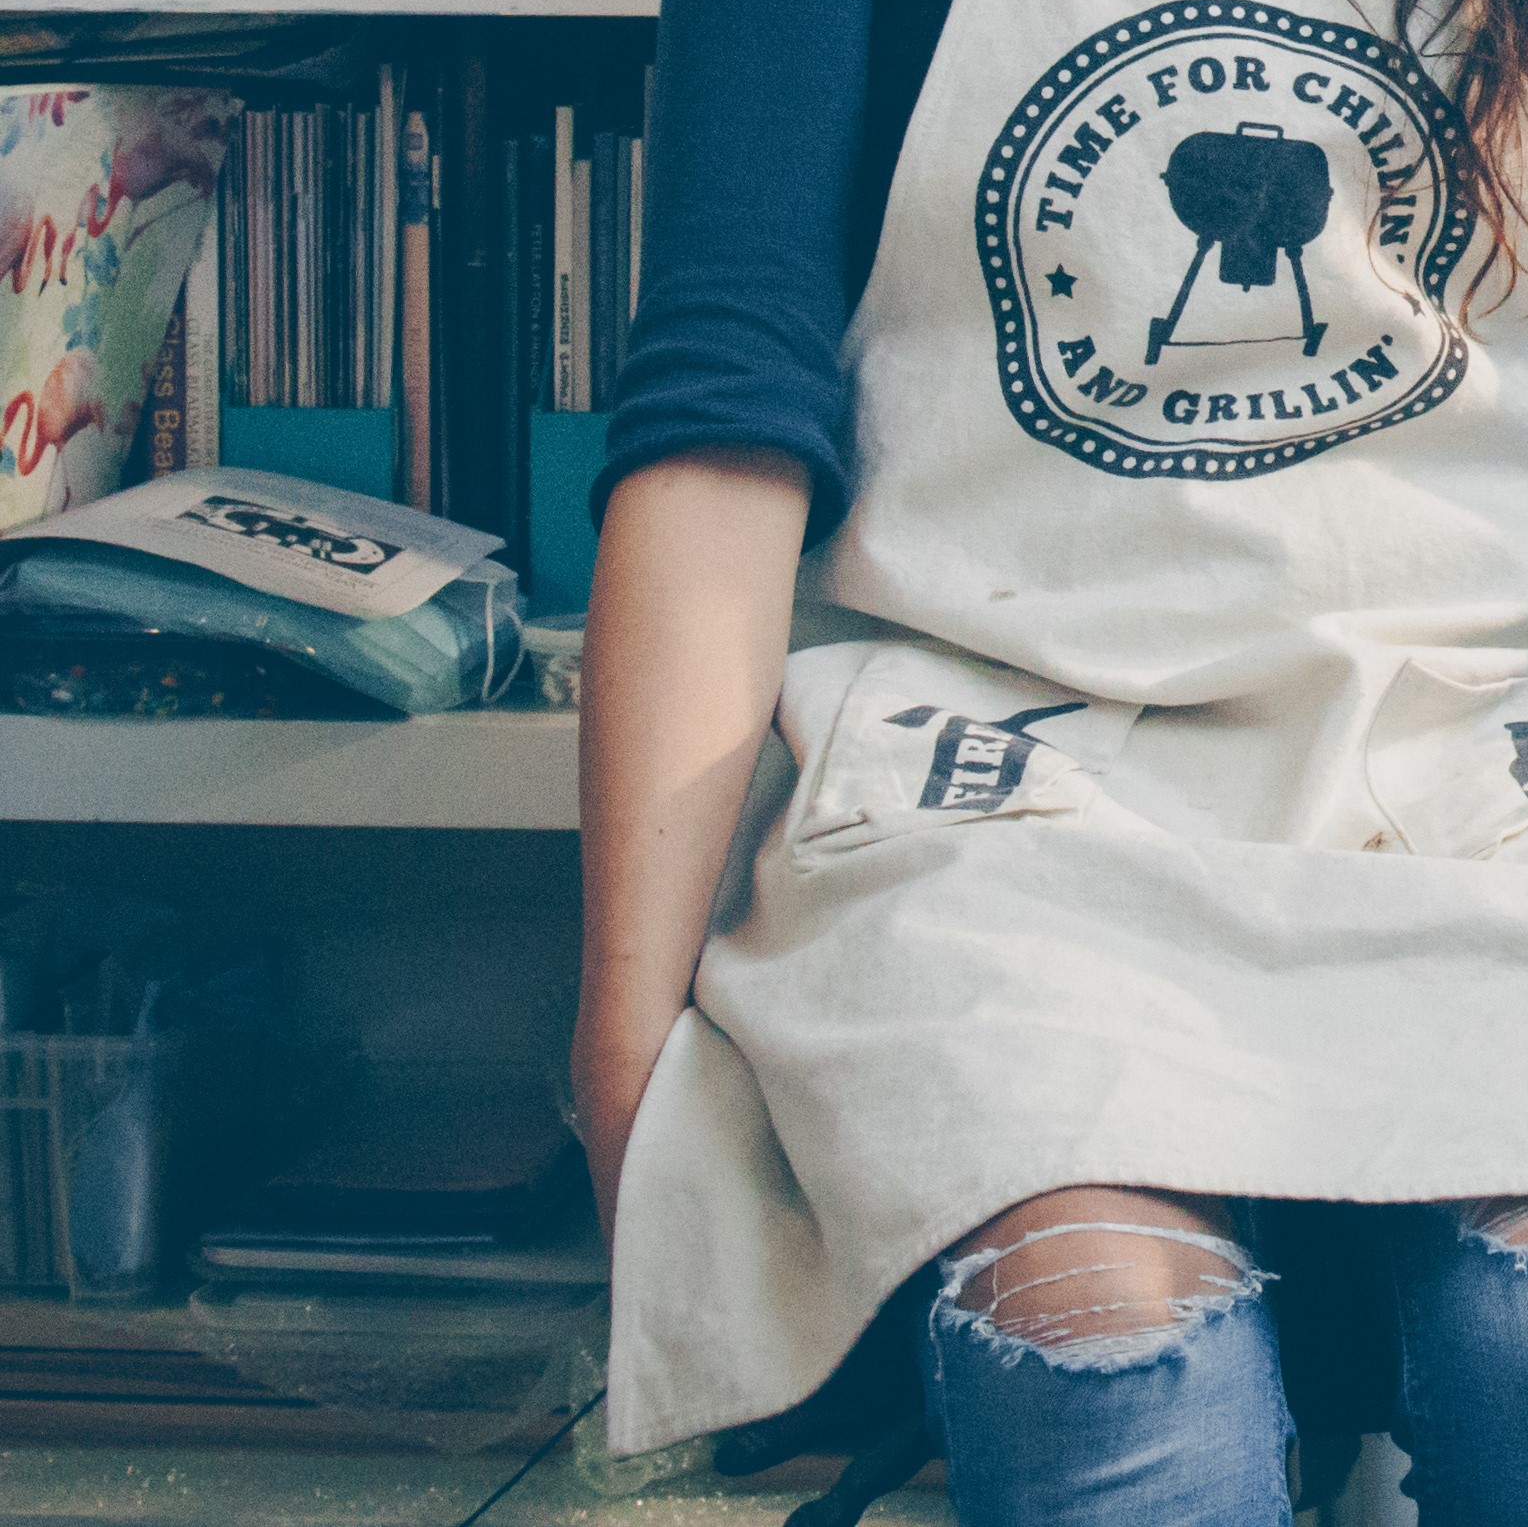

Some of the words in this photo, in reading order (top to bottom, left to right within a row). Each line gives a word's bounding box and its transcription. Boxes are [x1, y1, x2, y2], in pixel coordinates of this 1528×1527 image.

[1036, 94, 1141, 233] TIME
[1147, 56, 1270, 108] FOR
[1058, 336, 1148, 407] AND
[1162, 335, 1400, 425] GRILLIN'
